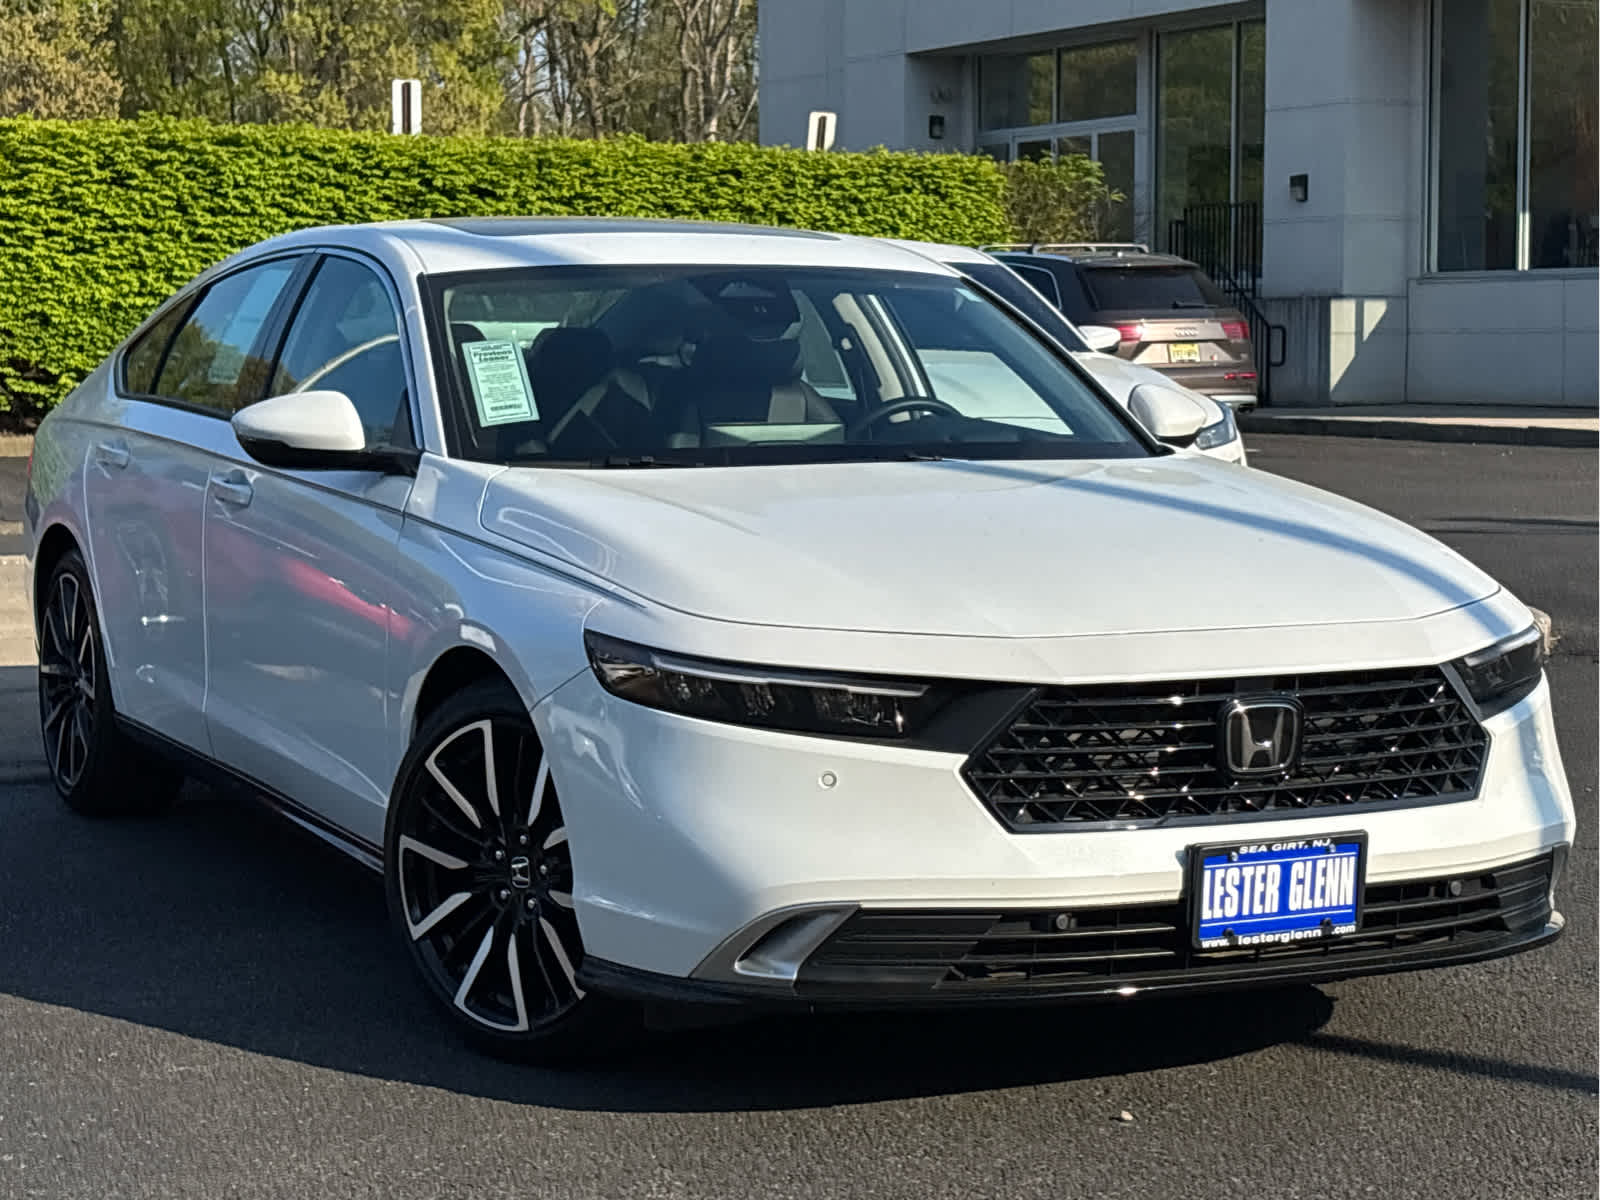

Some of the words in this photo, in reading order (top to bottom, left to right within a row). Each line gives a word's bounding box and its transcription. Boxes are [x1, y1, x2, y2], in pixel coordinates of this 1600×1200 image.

[1239, 844, 1267, 855] SEA
[1312, 838, 1331, 847] NJ
[1202, 864, 1281, 920] LESTER
[1288, 856, 1356, 911] GLENN
